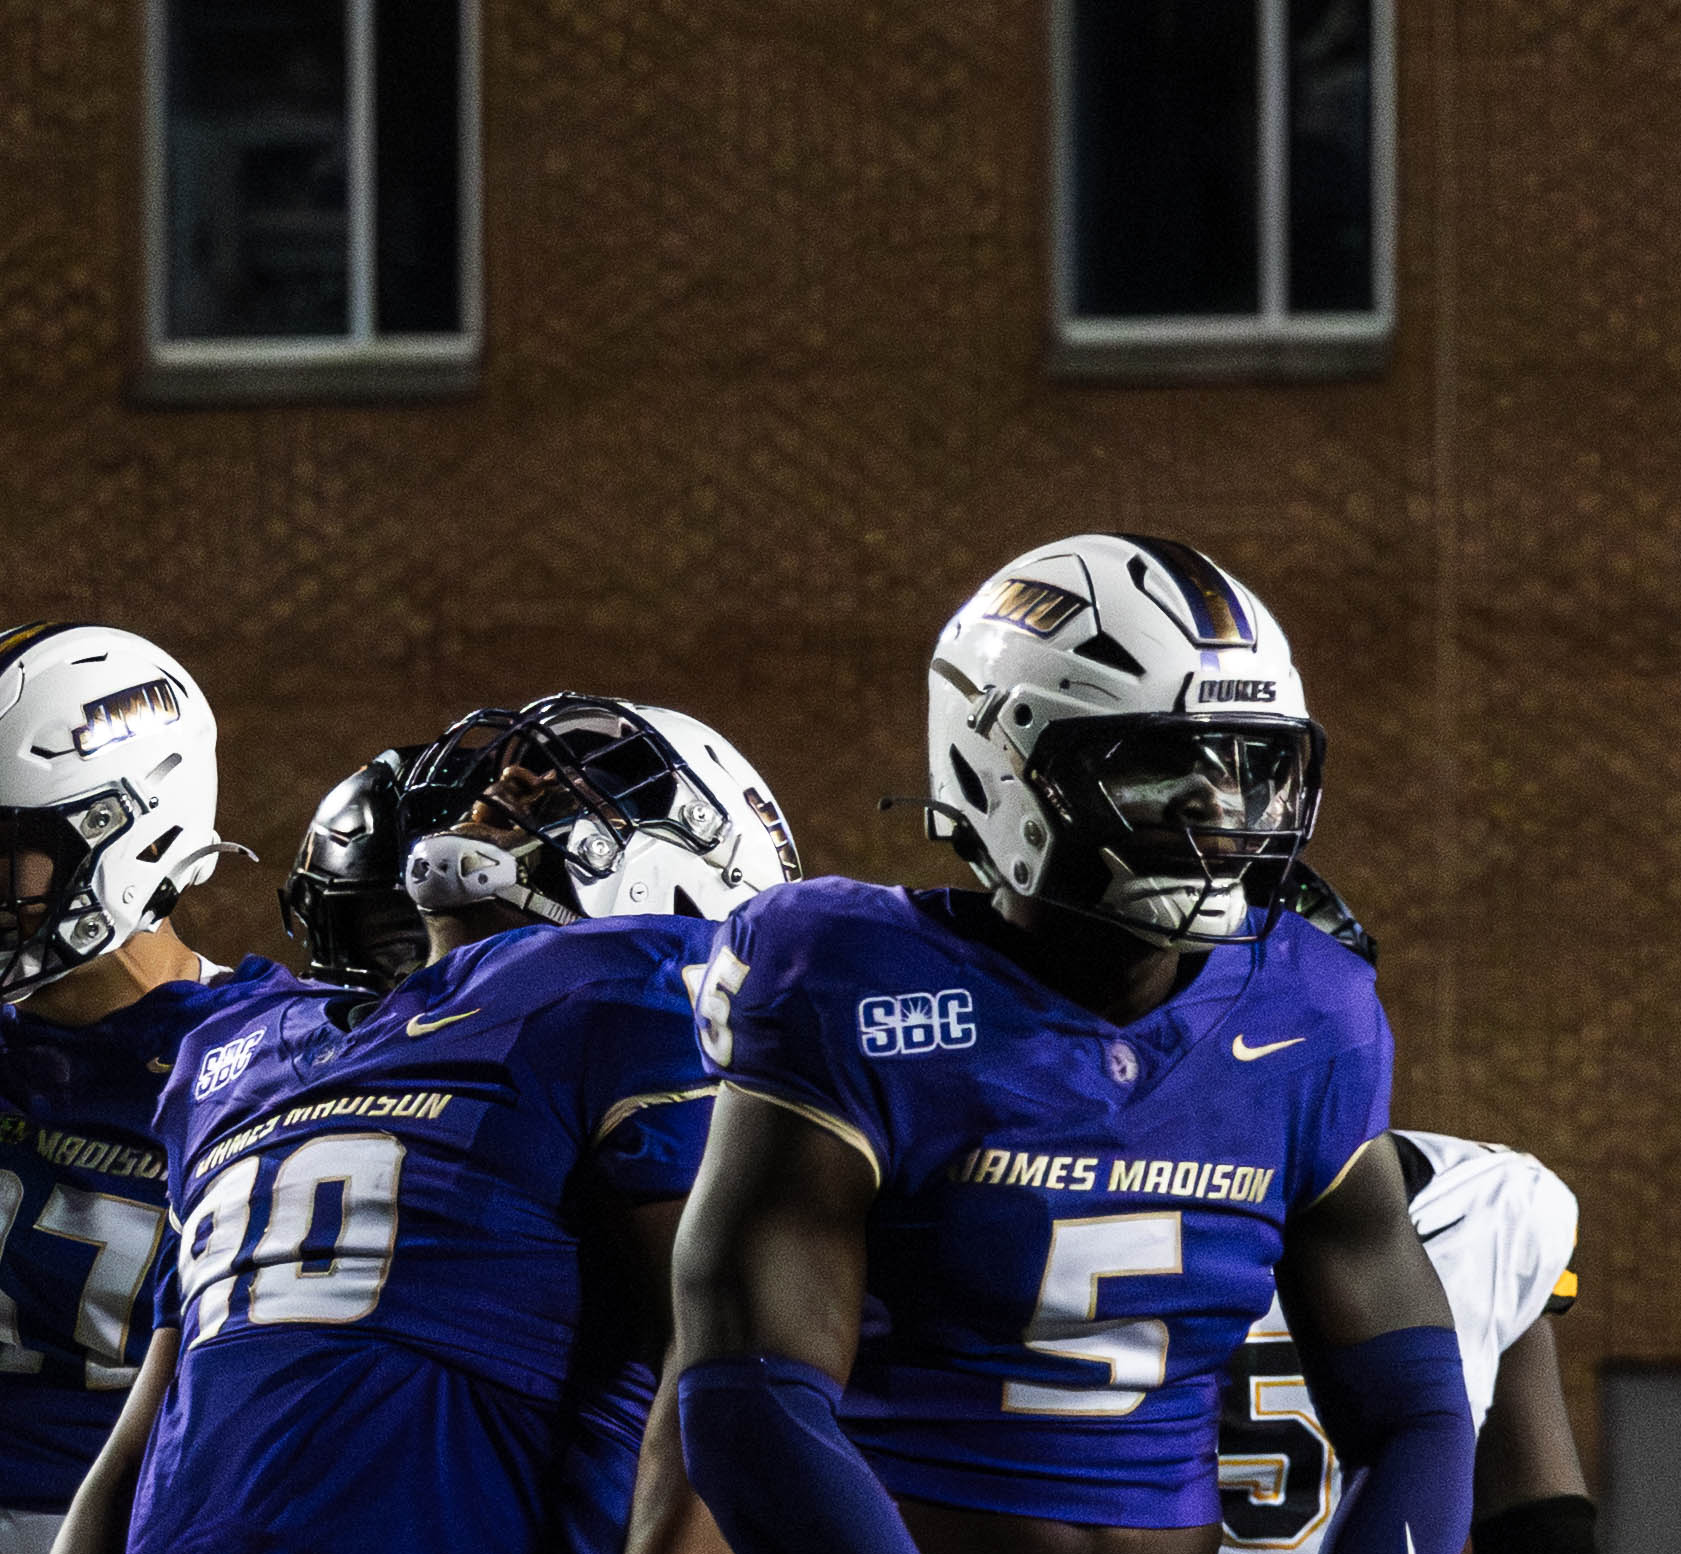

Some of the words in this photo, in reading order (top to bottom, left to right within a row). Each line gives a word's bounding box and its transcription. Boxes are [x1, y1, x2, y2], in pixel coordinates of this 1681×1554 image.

[858, 989, 976, 1057] SBC
[194, 1024, 268, 1101] SBC
[1107, 1159, 1275, 1204] MADISON
[178, 1131, 407, 1350] 90
[1000, 1210, 1183, 1417] 5
